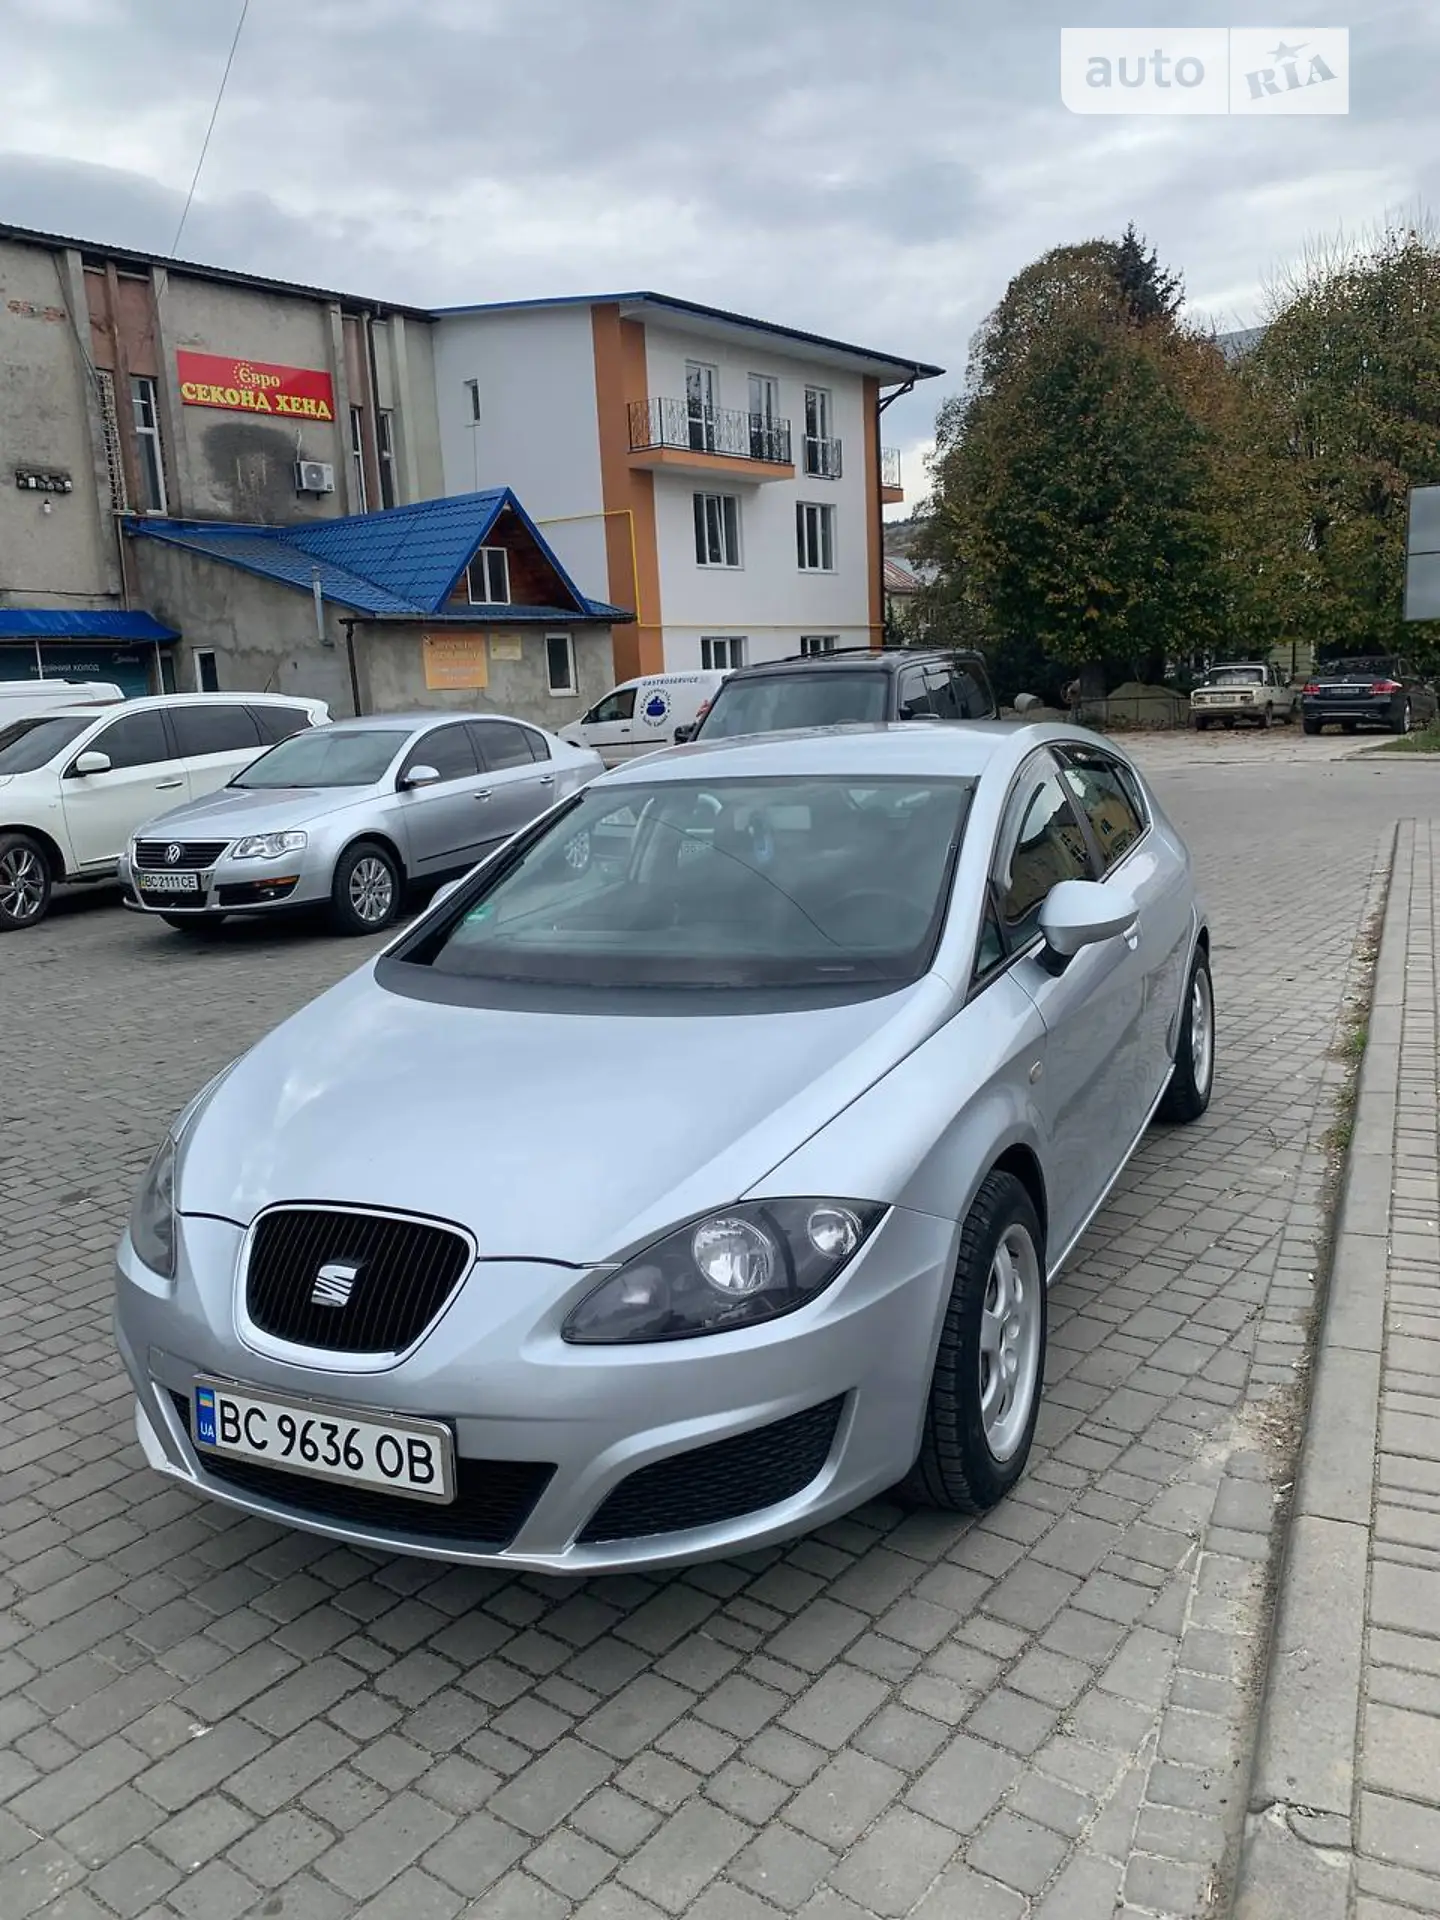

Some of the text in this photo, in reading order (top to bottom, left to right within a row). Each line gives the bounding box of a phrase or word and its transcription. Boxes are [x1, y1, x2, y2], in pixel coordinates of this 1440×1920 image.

[239, 367, 281, 389] Євро
[181, 382, 332, 419] СЕКОНД ХЕНД
[182, 876, 196, 888] CE
[201, 1421, 215, 1438] UA
[219, 1399, 435, 1484] BC 9636 OB
